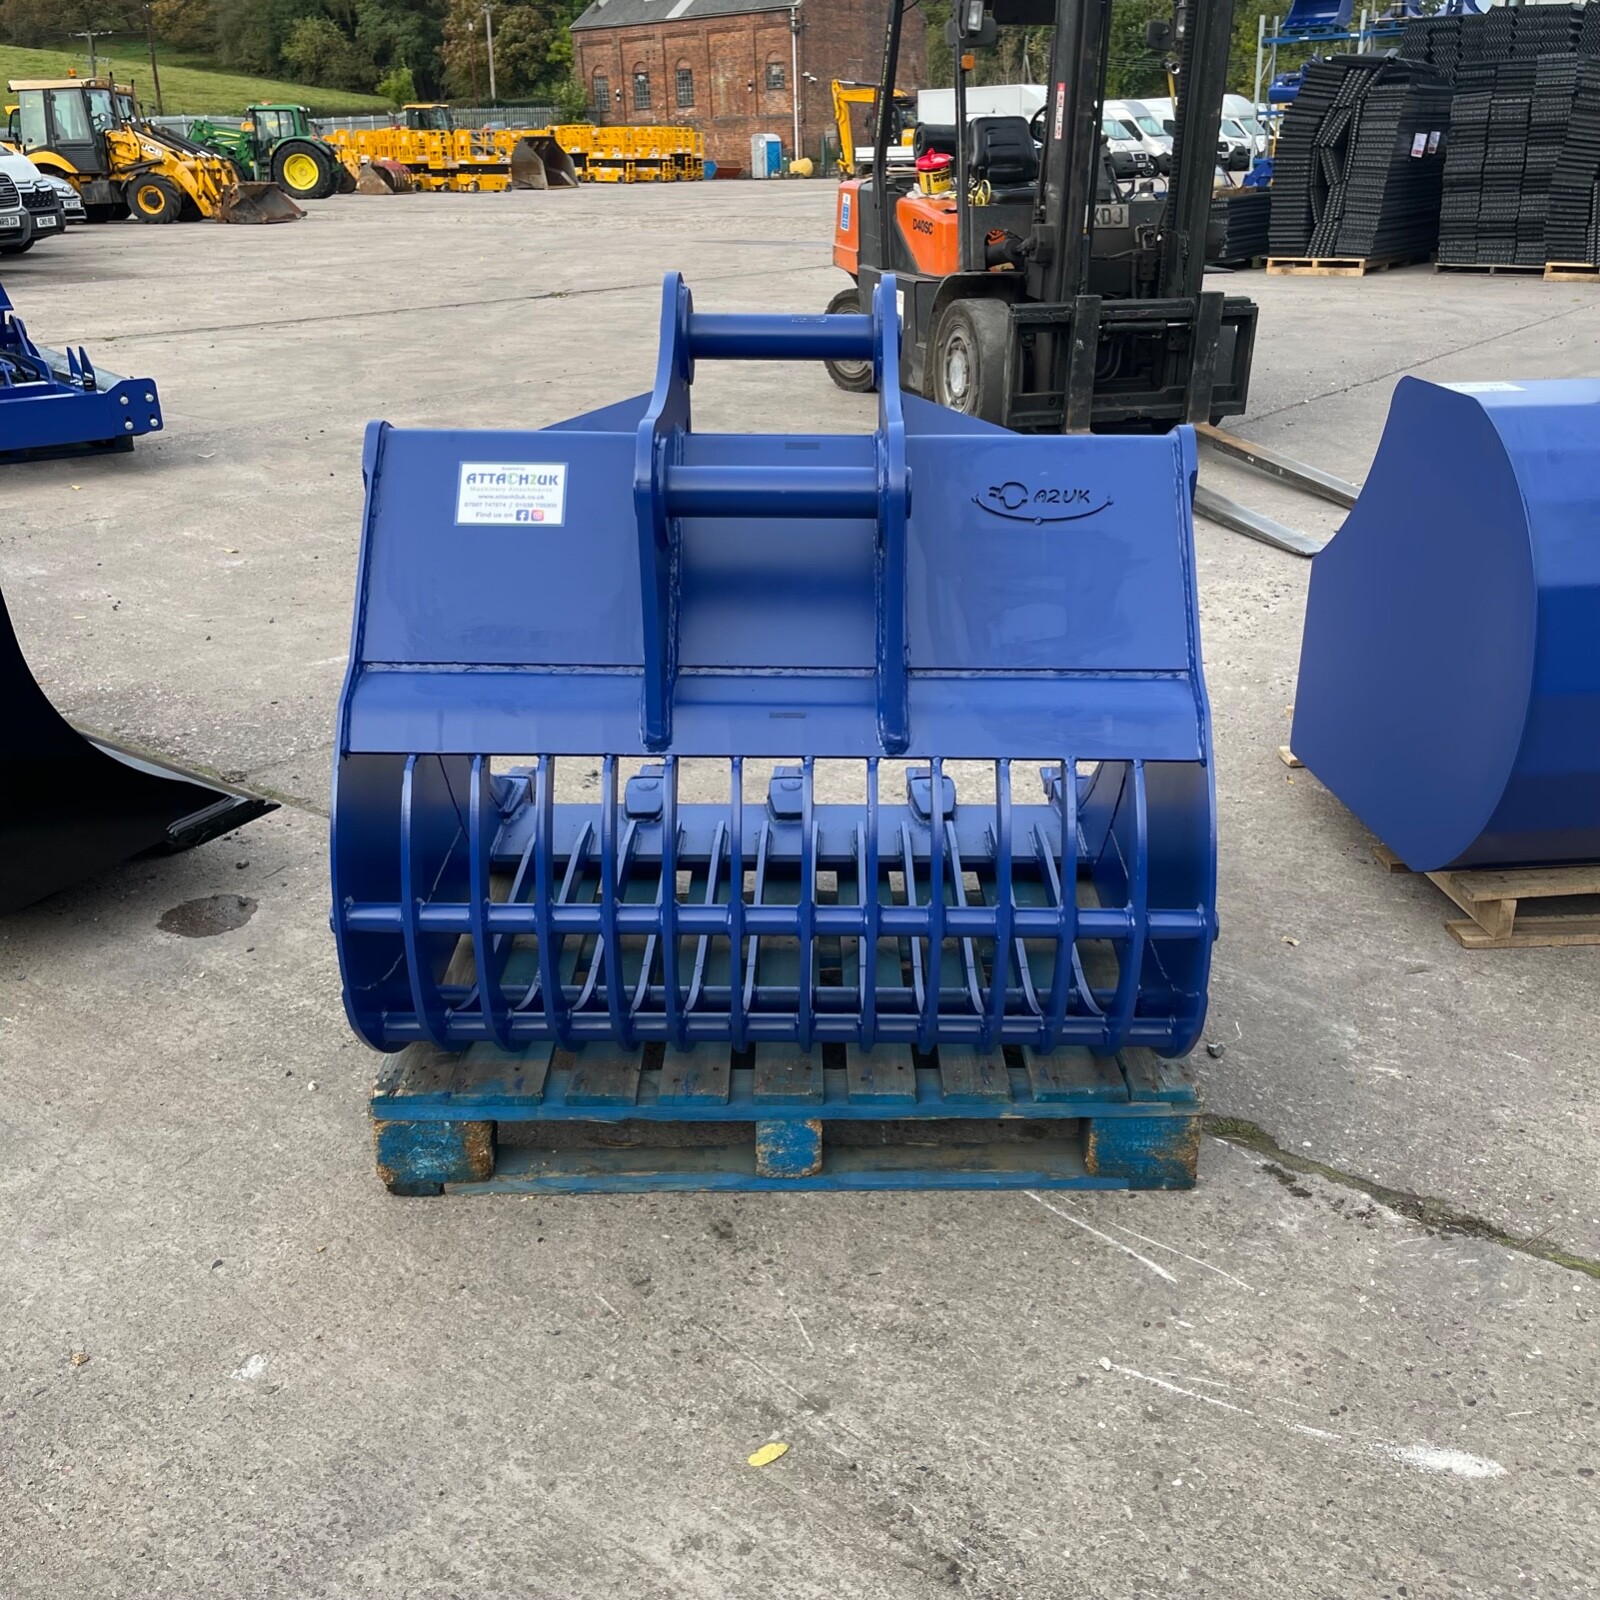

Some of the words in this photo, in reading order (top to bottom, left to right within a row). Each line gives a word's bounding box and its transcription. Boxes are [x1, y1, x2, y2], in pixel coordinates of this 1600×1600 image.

[141, 143, 163, 158] JCB
[912, 218, 934, 235] D40SC
[466, 472, 559, 486] ATTACH2UK
[1033, 489, 1090, 504] A2UK
